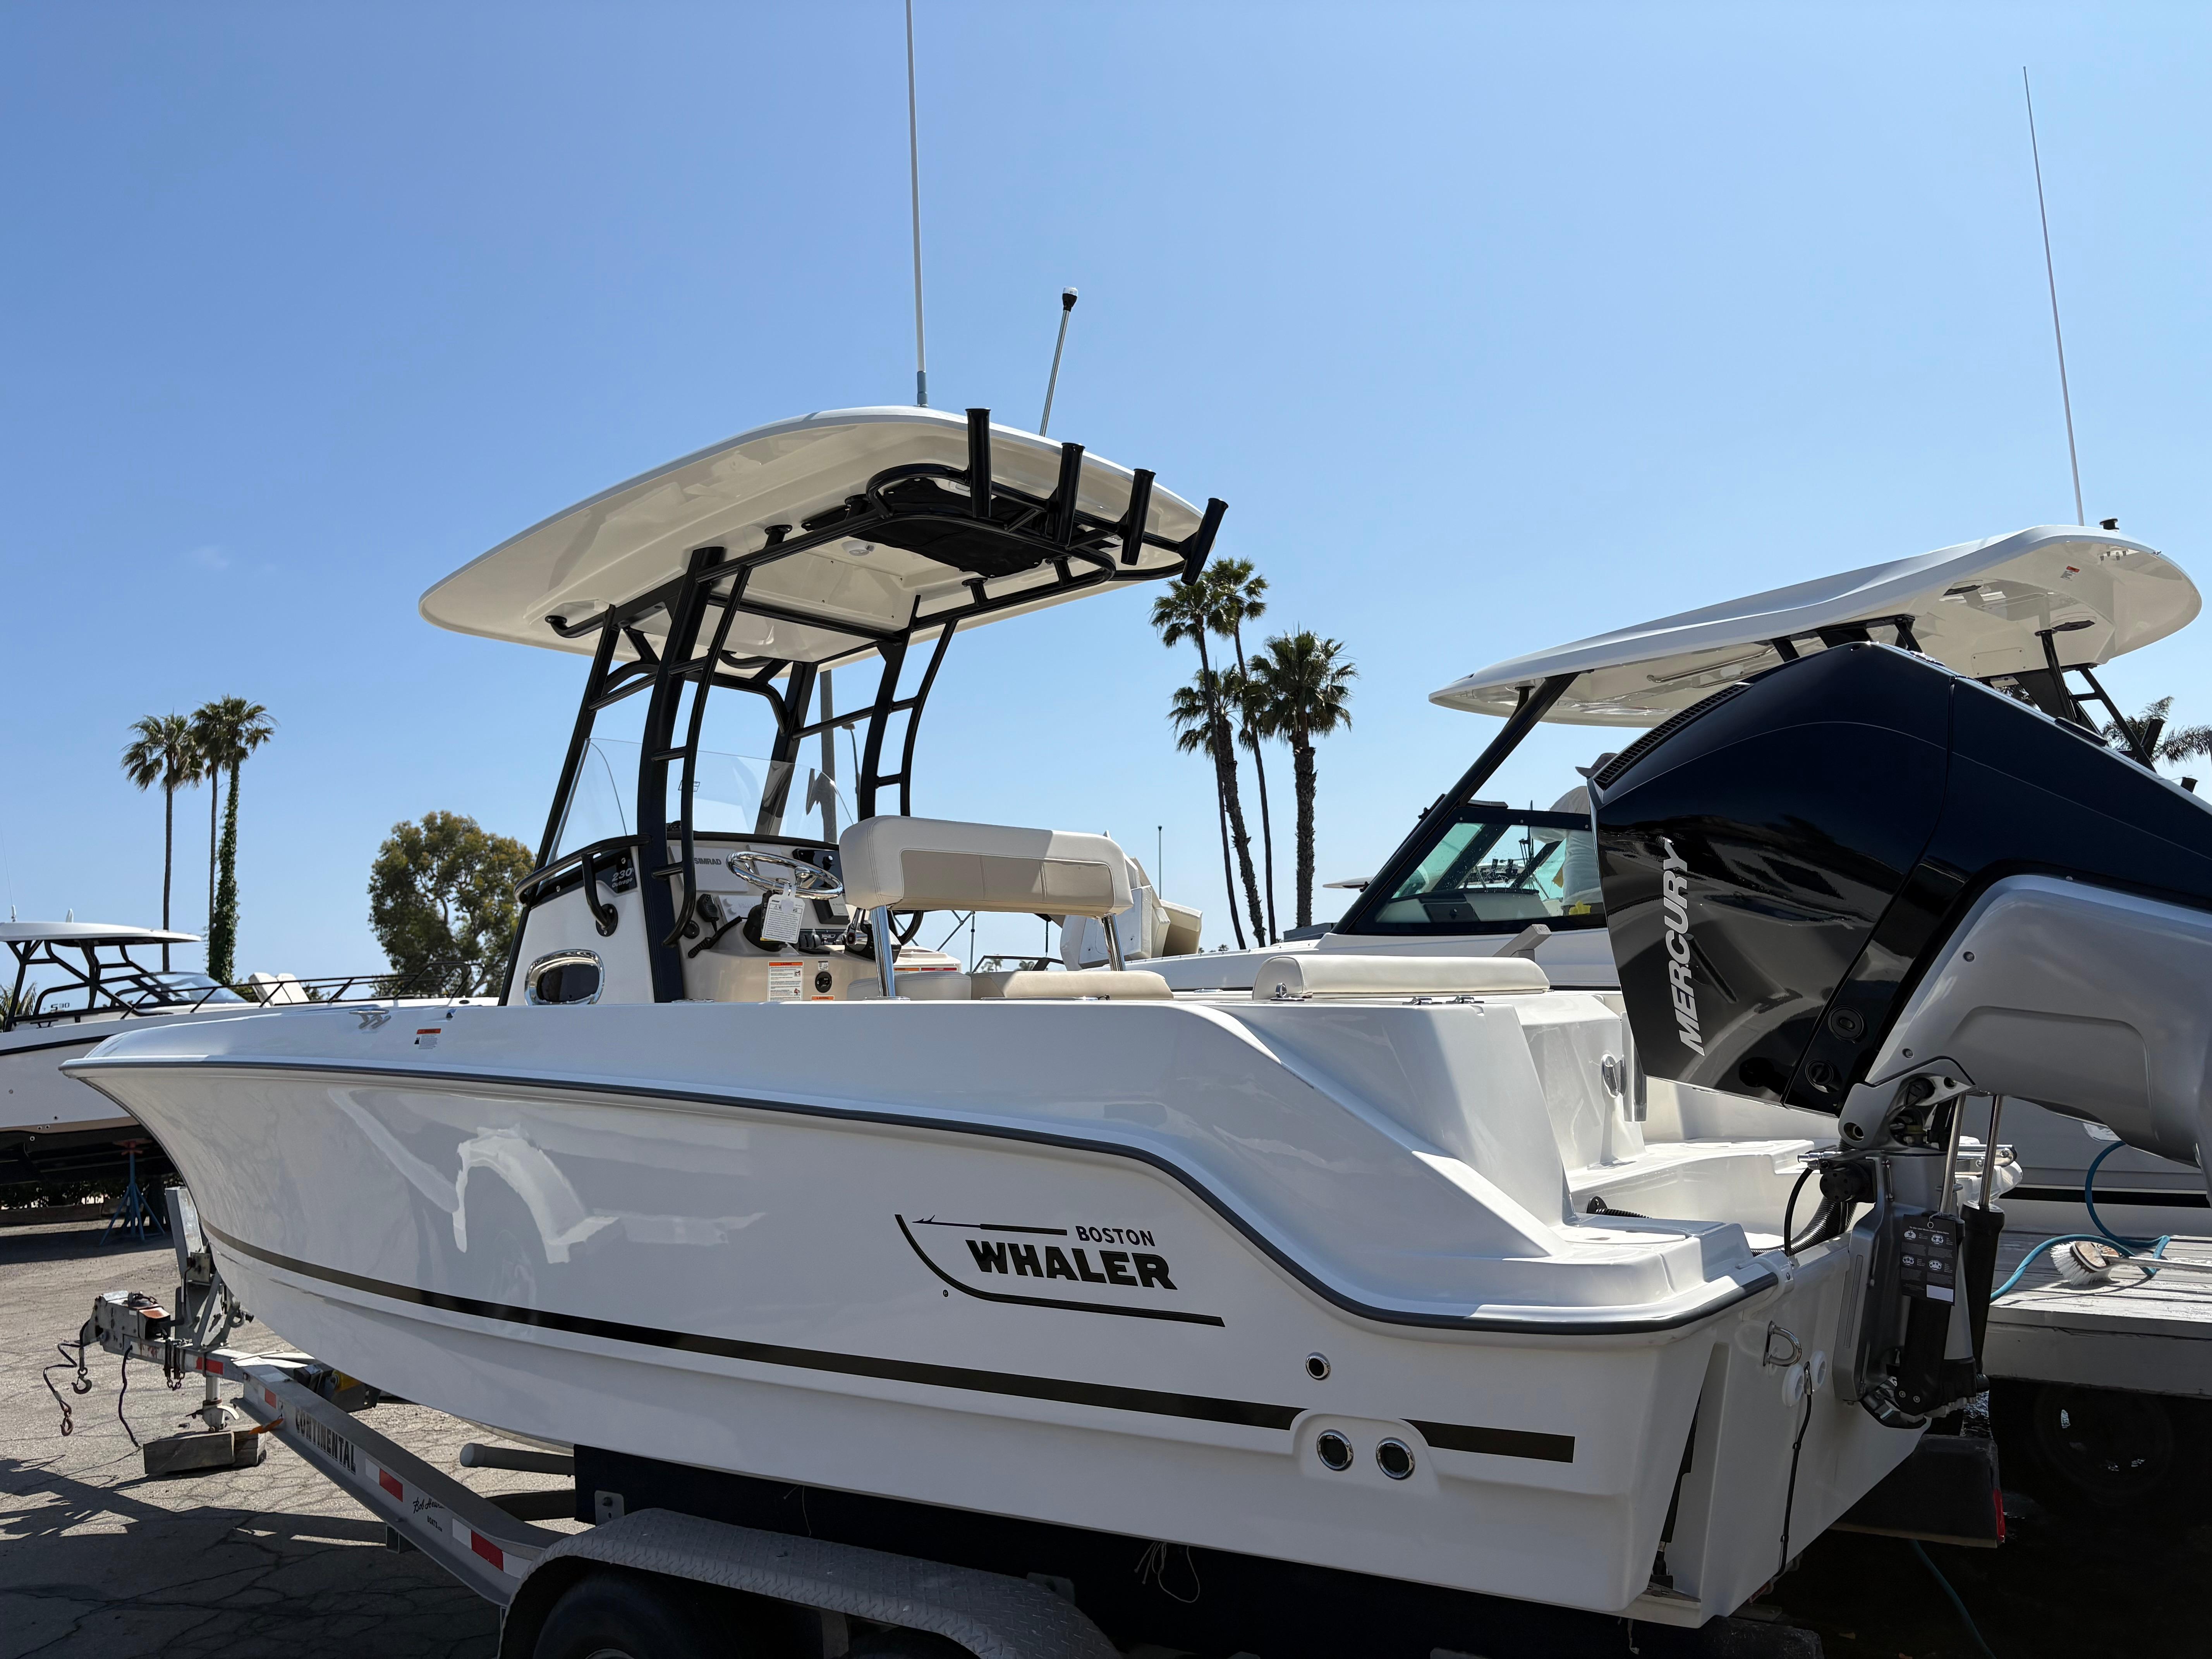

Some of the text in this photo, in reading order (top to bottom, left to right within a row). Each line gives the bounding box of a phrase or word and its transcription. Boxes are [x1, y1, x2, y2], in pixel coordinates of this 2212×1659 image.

[611, 867, 632, 882] 230
[612, 878, 633, 888] Outrage
[1663, 838, 1705, 1056] MERCURY
[1075, 1226, 1156, 1247] BOSTON
[965, 1239, 1178, 1290] WHALER
[295, 1407, 356, 1475] CONTINENTAL
[413, 1497, 425, 1514] Bob
